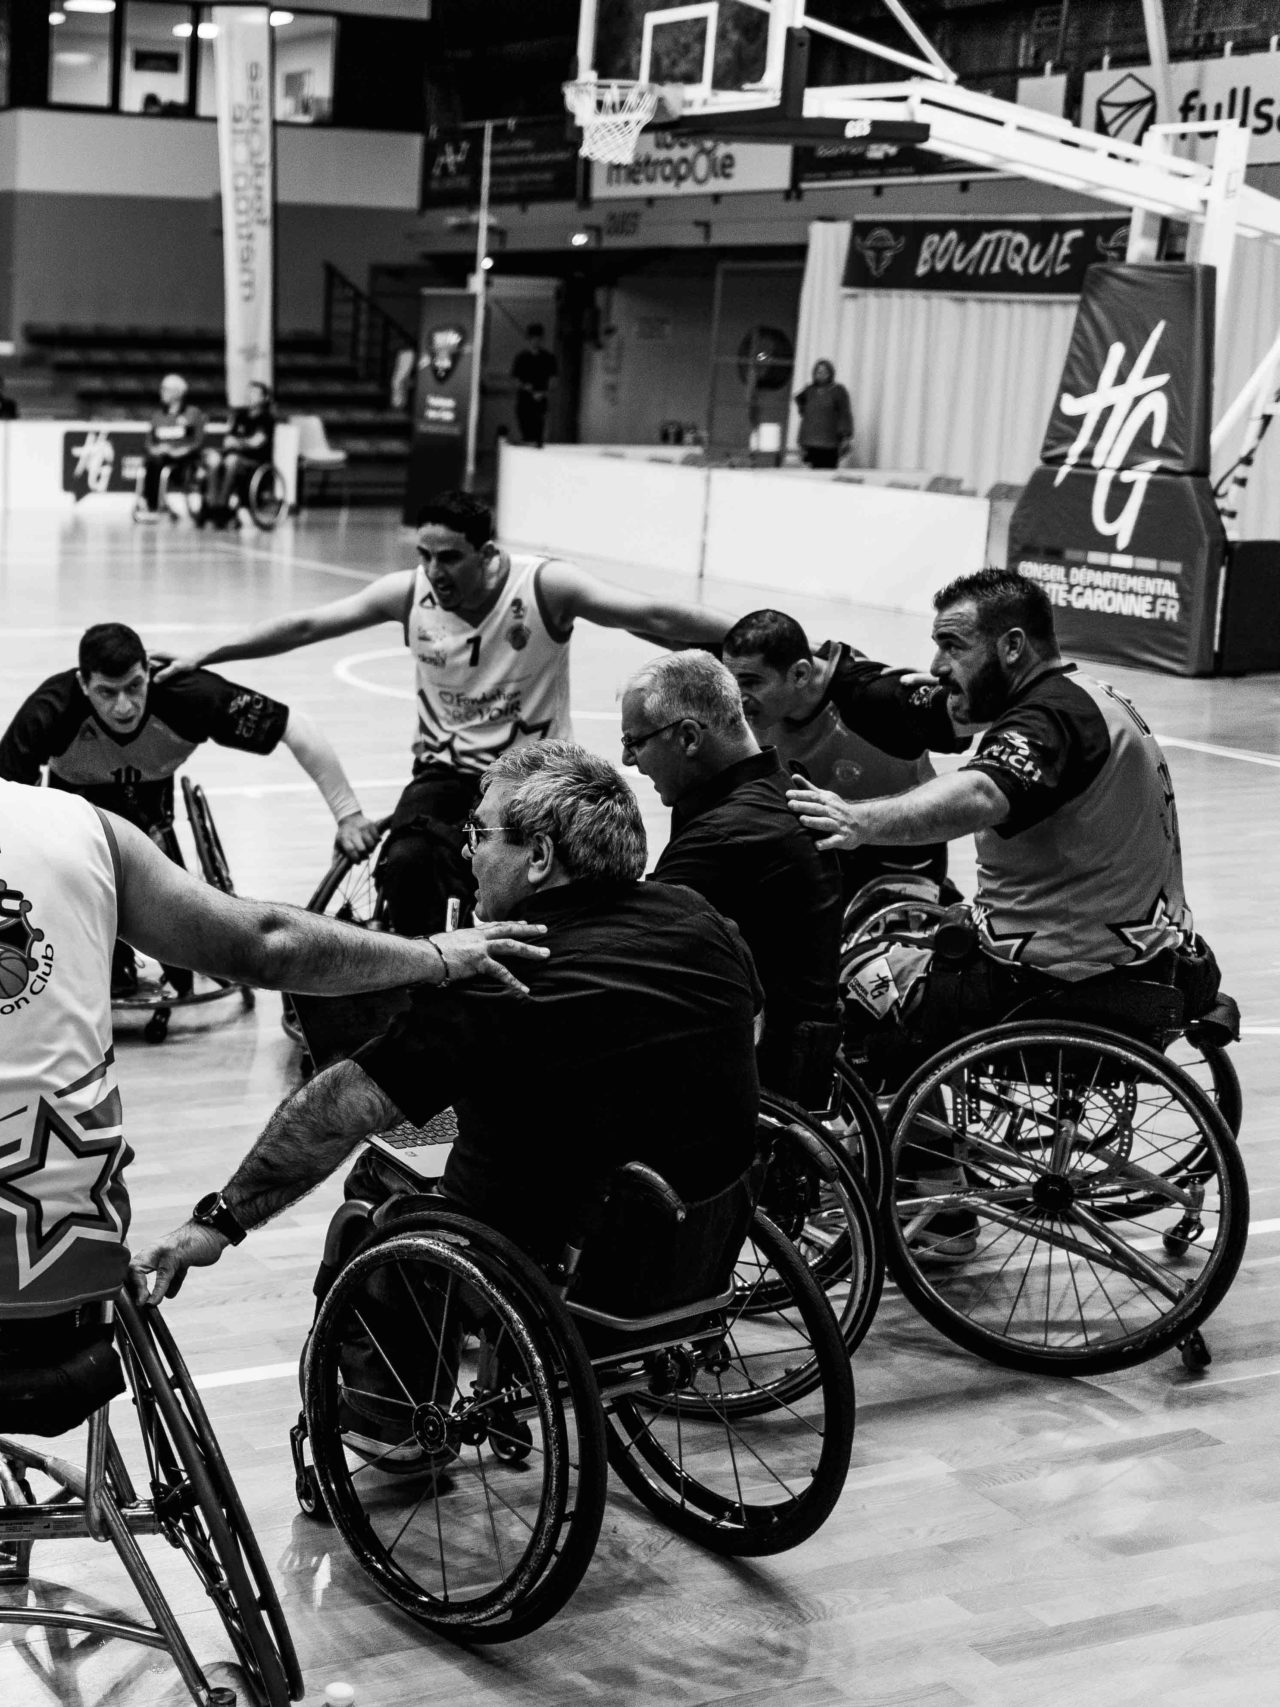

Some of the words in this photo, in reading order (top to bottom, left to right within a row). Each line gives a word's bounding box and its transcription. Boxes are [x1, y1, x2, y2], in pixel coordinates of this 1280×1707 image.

[1178, 86, 1280, 140] fulls
[916, 229, 1084, 278] BOUTIQUE
[1019, 561, 1068, 579] CONSEIL
[1070, 567, 1179, 599] DÉPARTEMENTAL
[1044, 580, 1180, 622] TE-GARONNE.FR
[30, 943, 55, 996] Club
